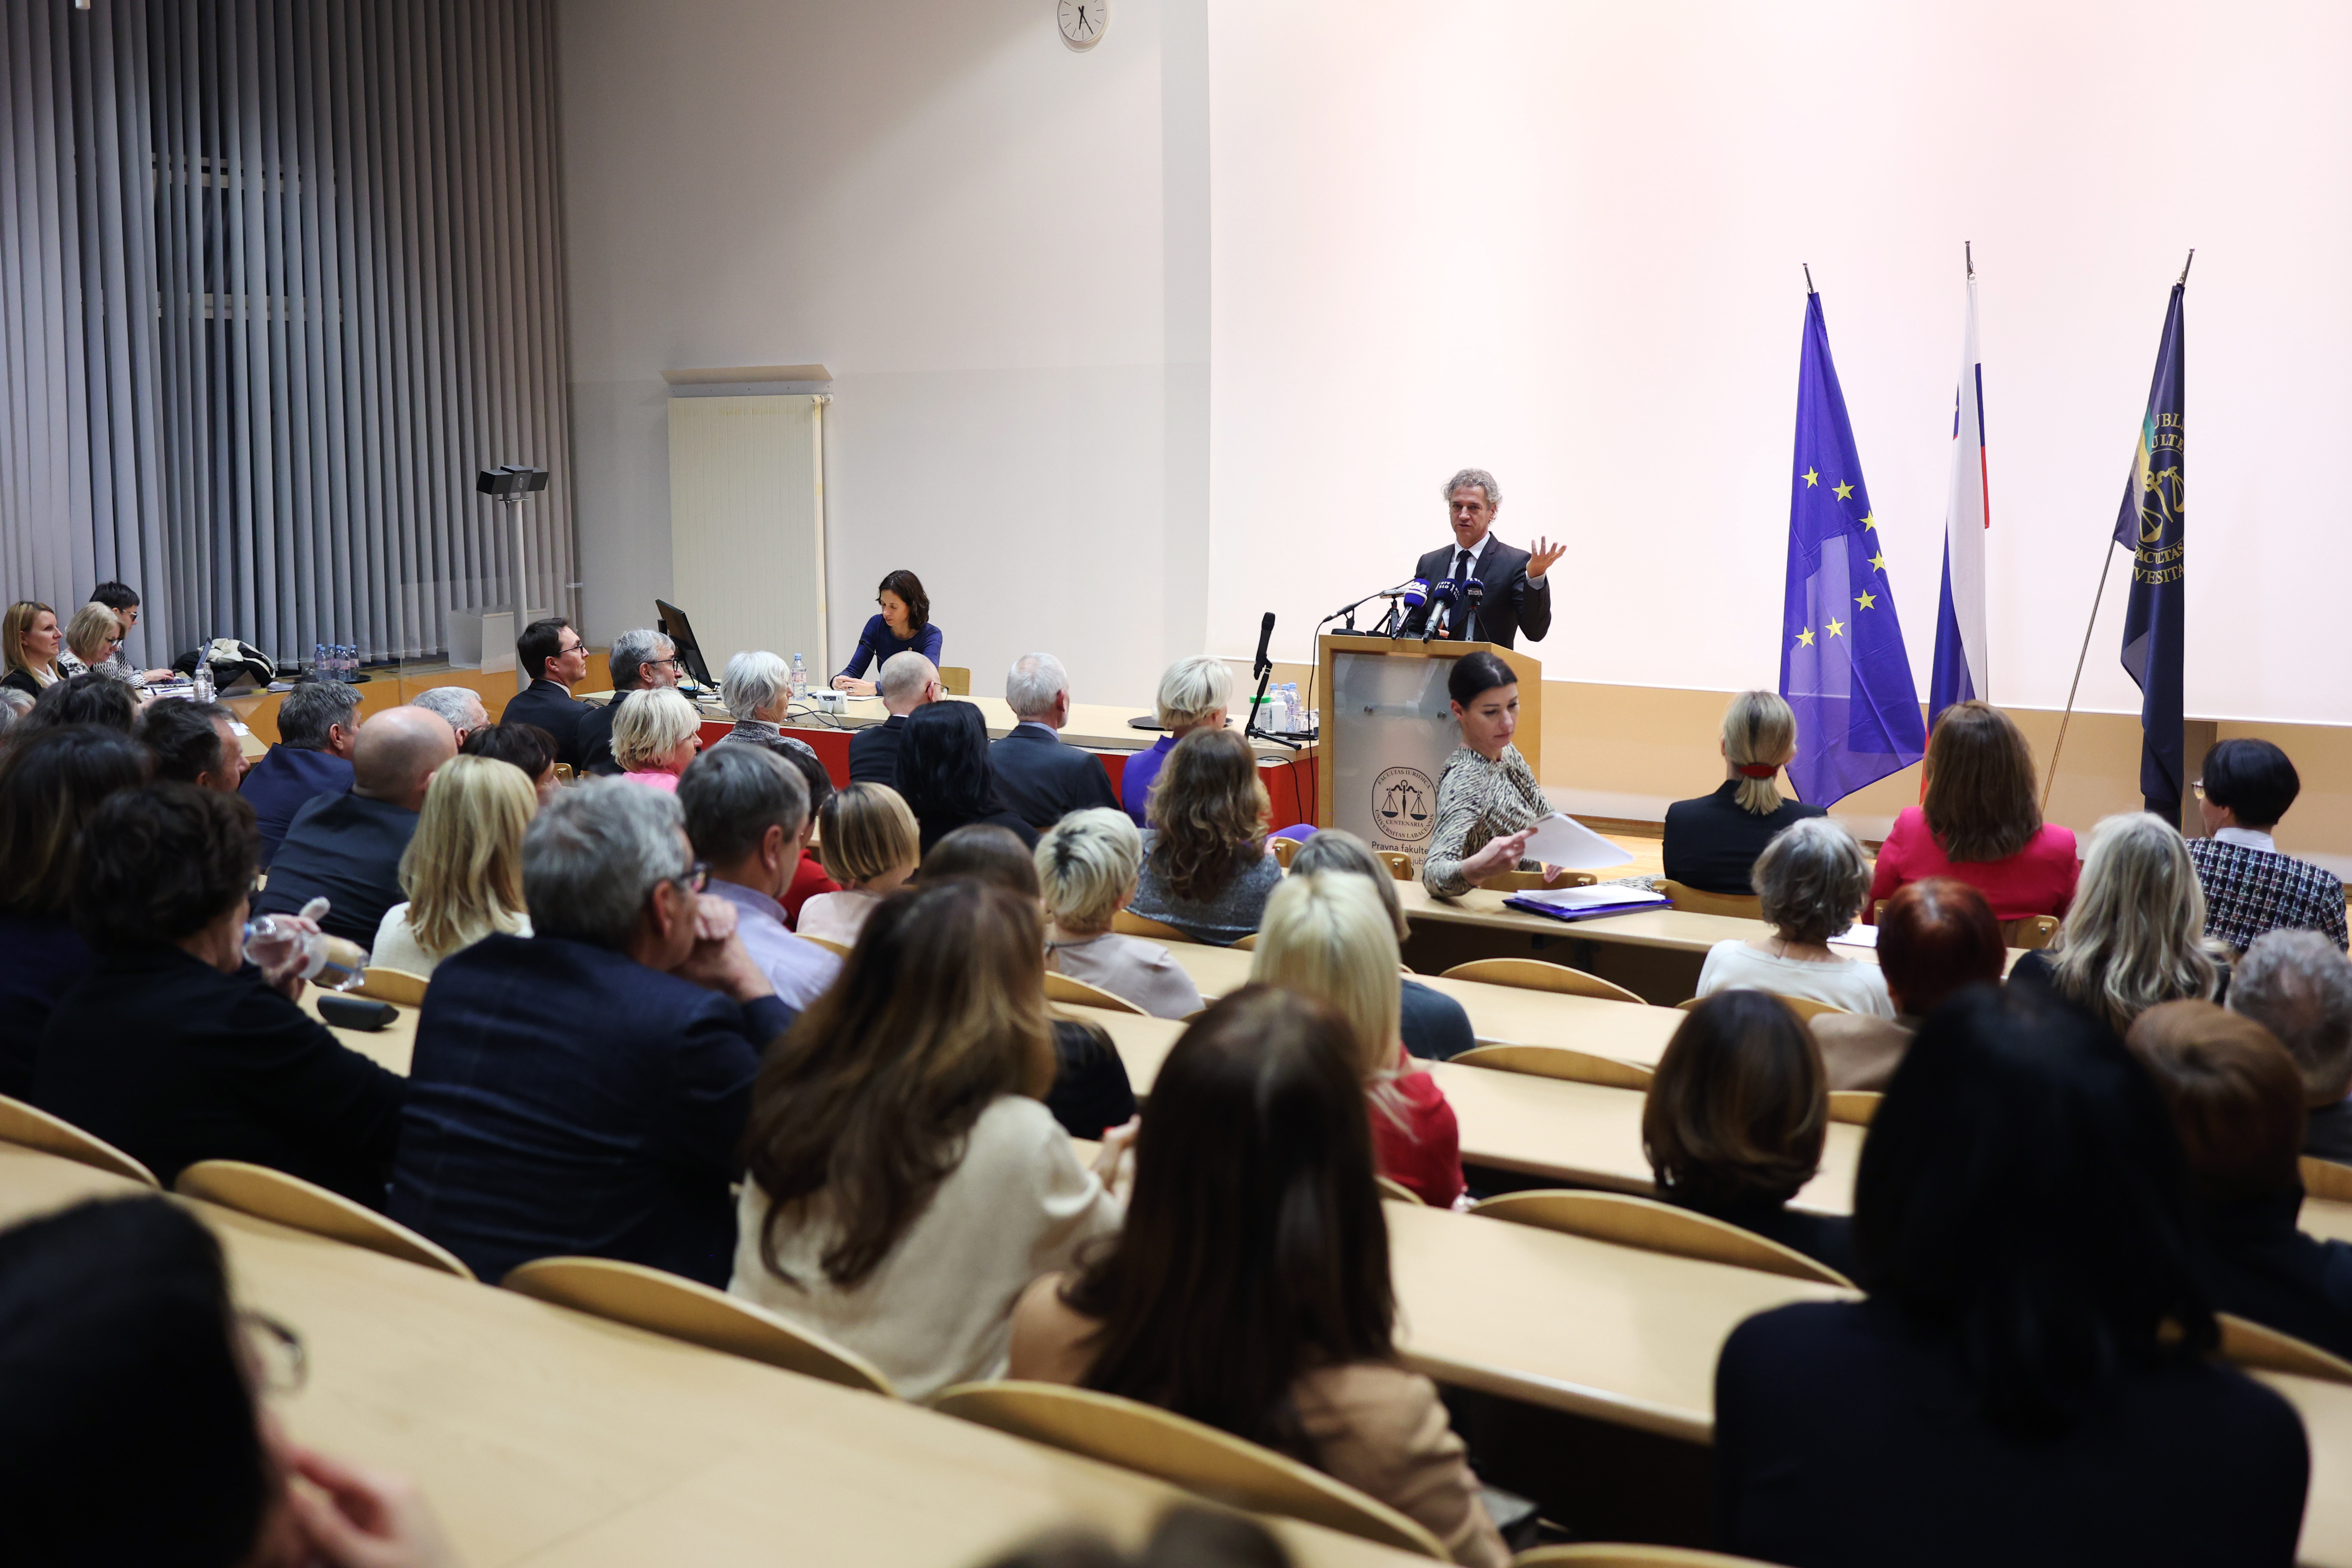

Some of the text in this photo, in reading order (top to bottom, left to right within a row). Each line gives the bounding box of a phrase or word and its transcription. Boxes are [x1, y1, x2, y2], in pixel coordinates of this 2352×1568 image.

[1378, 769, 1431, 789] FACULTAS IURIDICA
[1375, 809, 1434, 838] UNIVERSITAS LABACENSIS
[1386, 819, 1424, 827] CENTENARIA
[1372, 841, 1399, 851] Pravna
